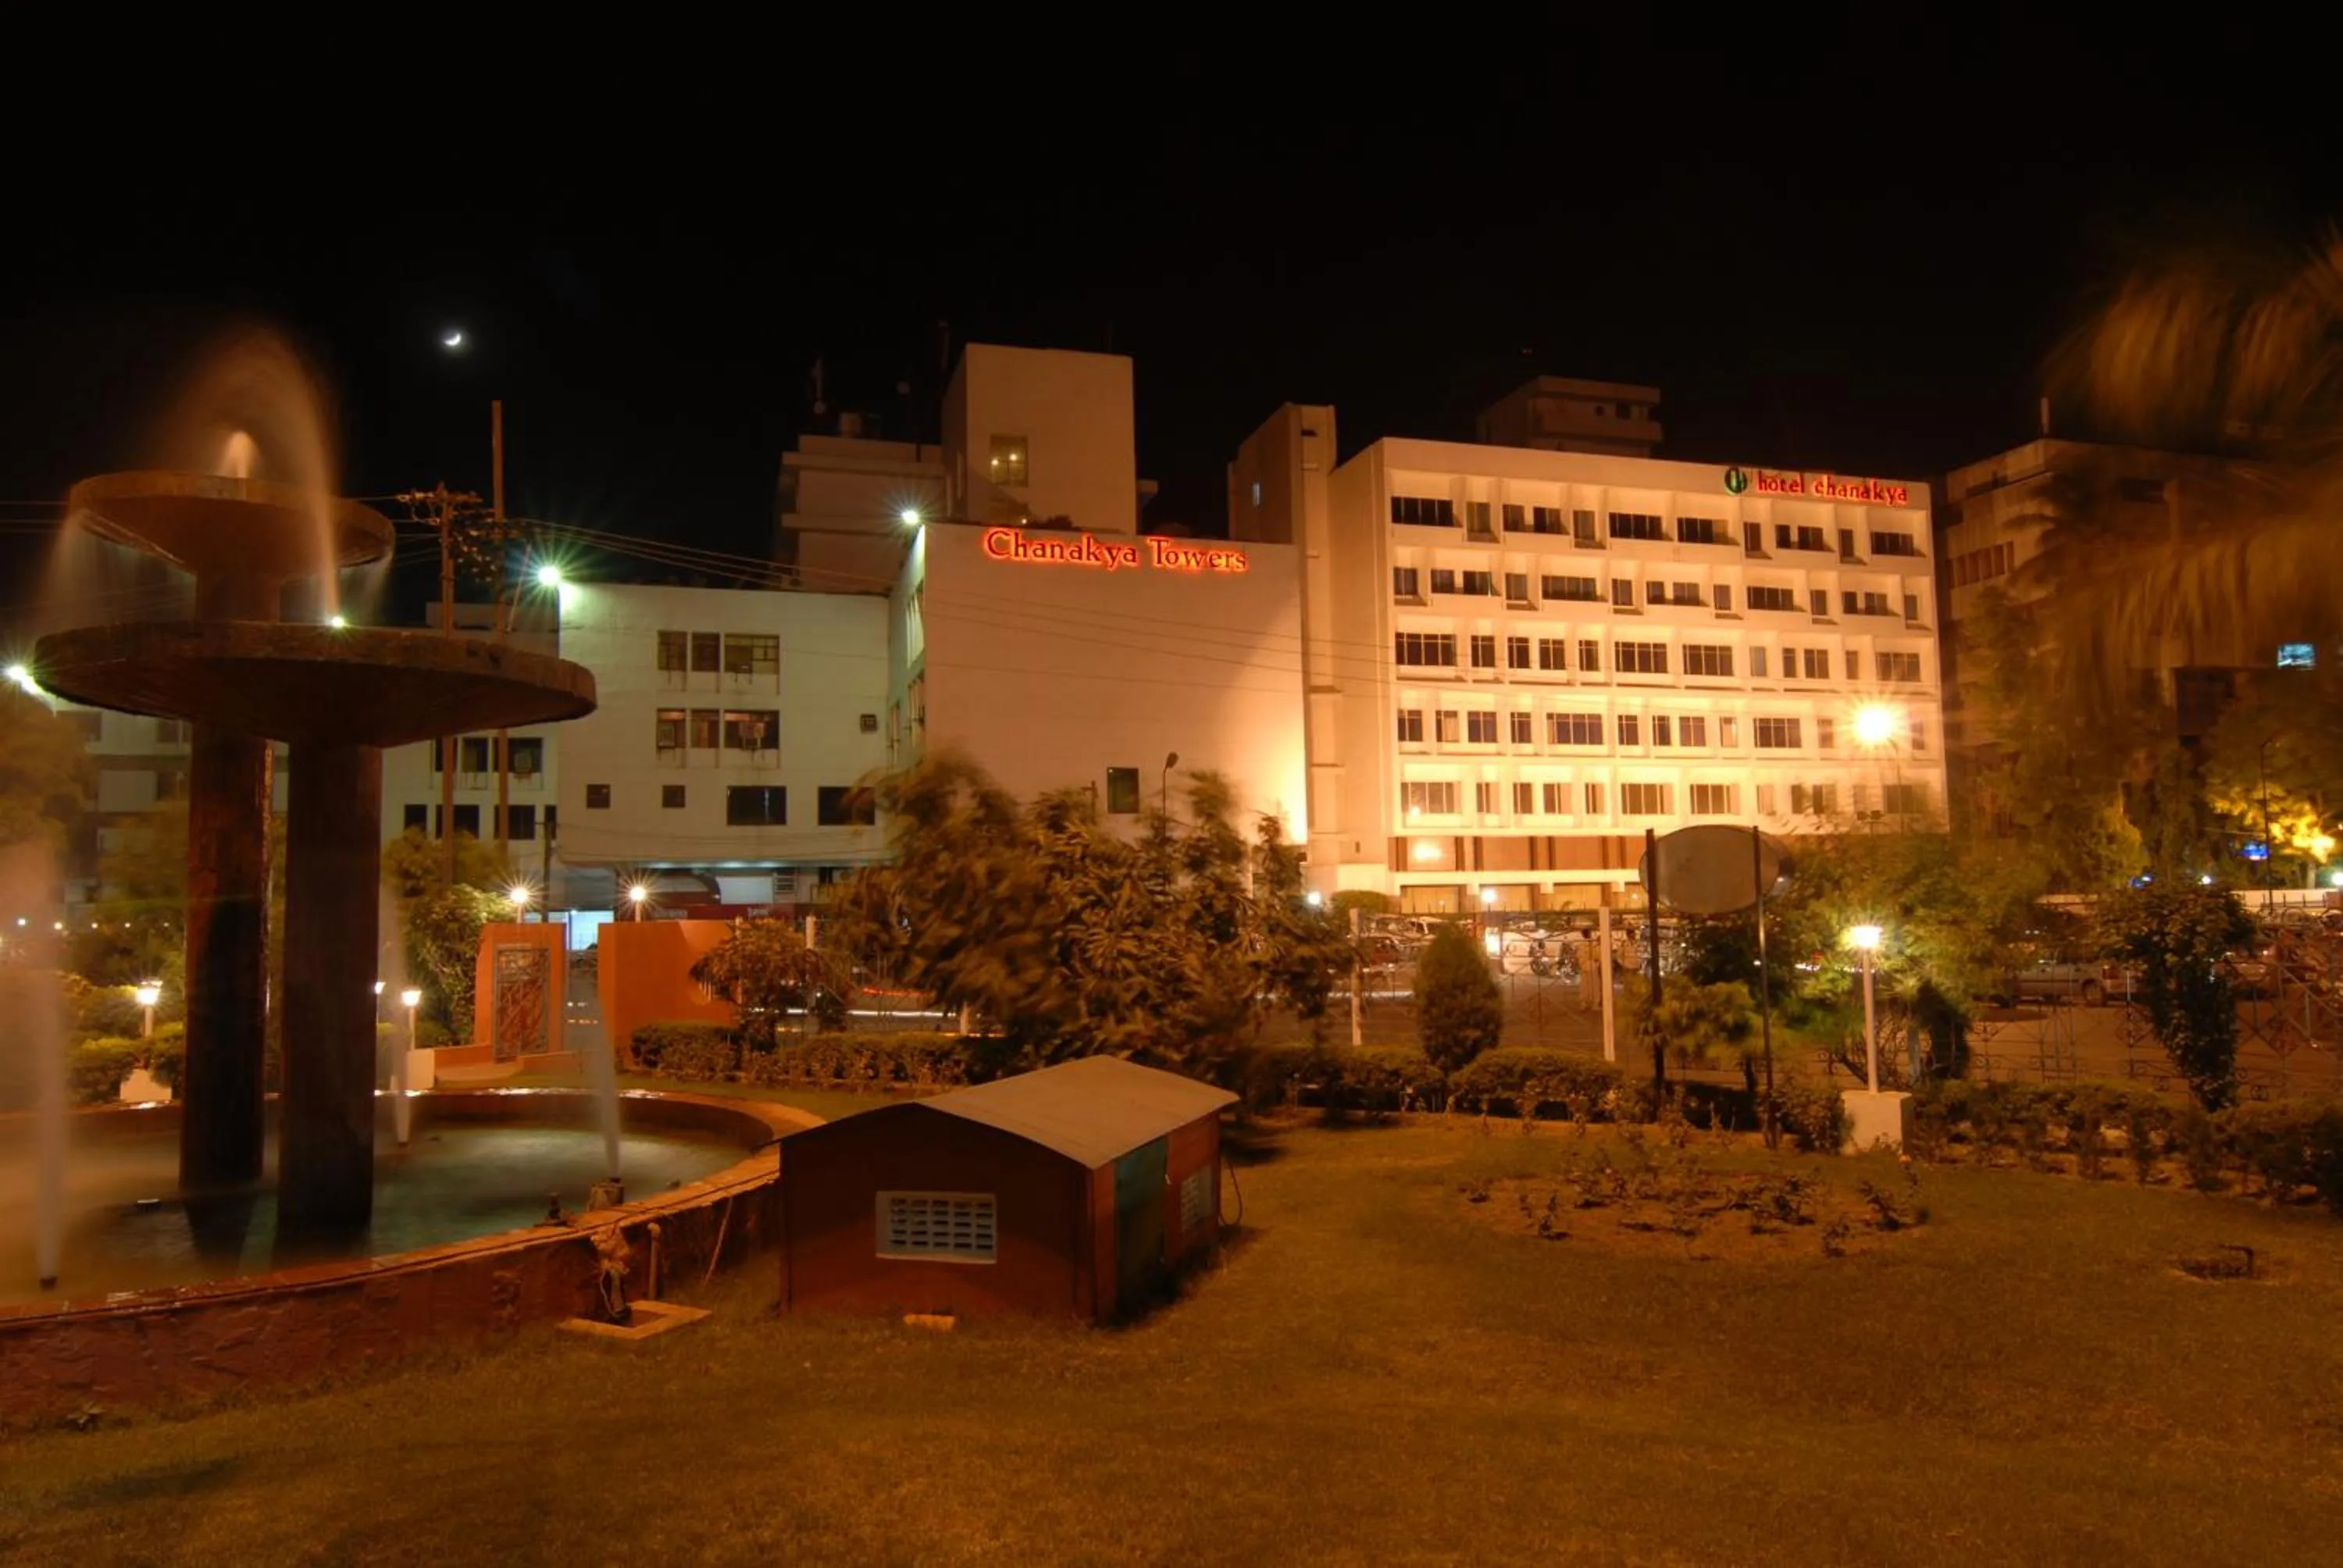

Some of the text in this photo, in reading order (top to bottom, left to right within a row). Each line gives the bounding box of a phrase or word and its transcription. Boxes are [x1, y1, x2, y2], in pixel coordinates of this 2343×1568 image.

[1757, 469, 1907, 505] hotel chanakya
[985, 529, 1248, 572] Chanakya Towers
